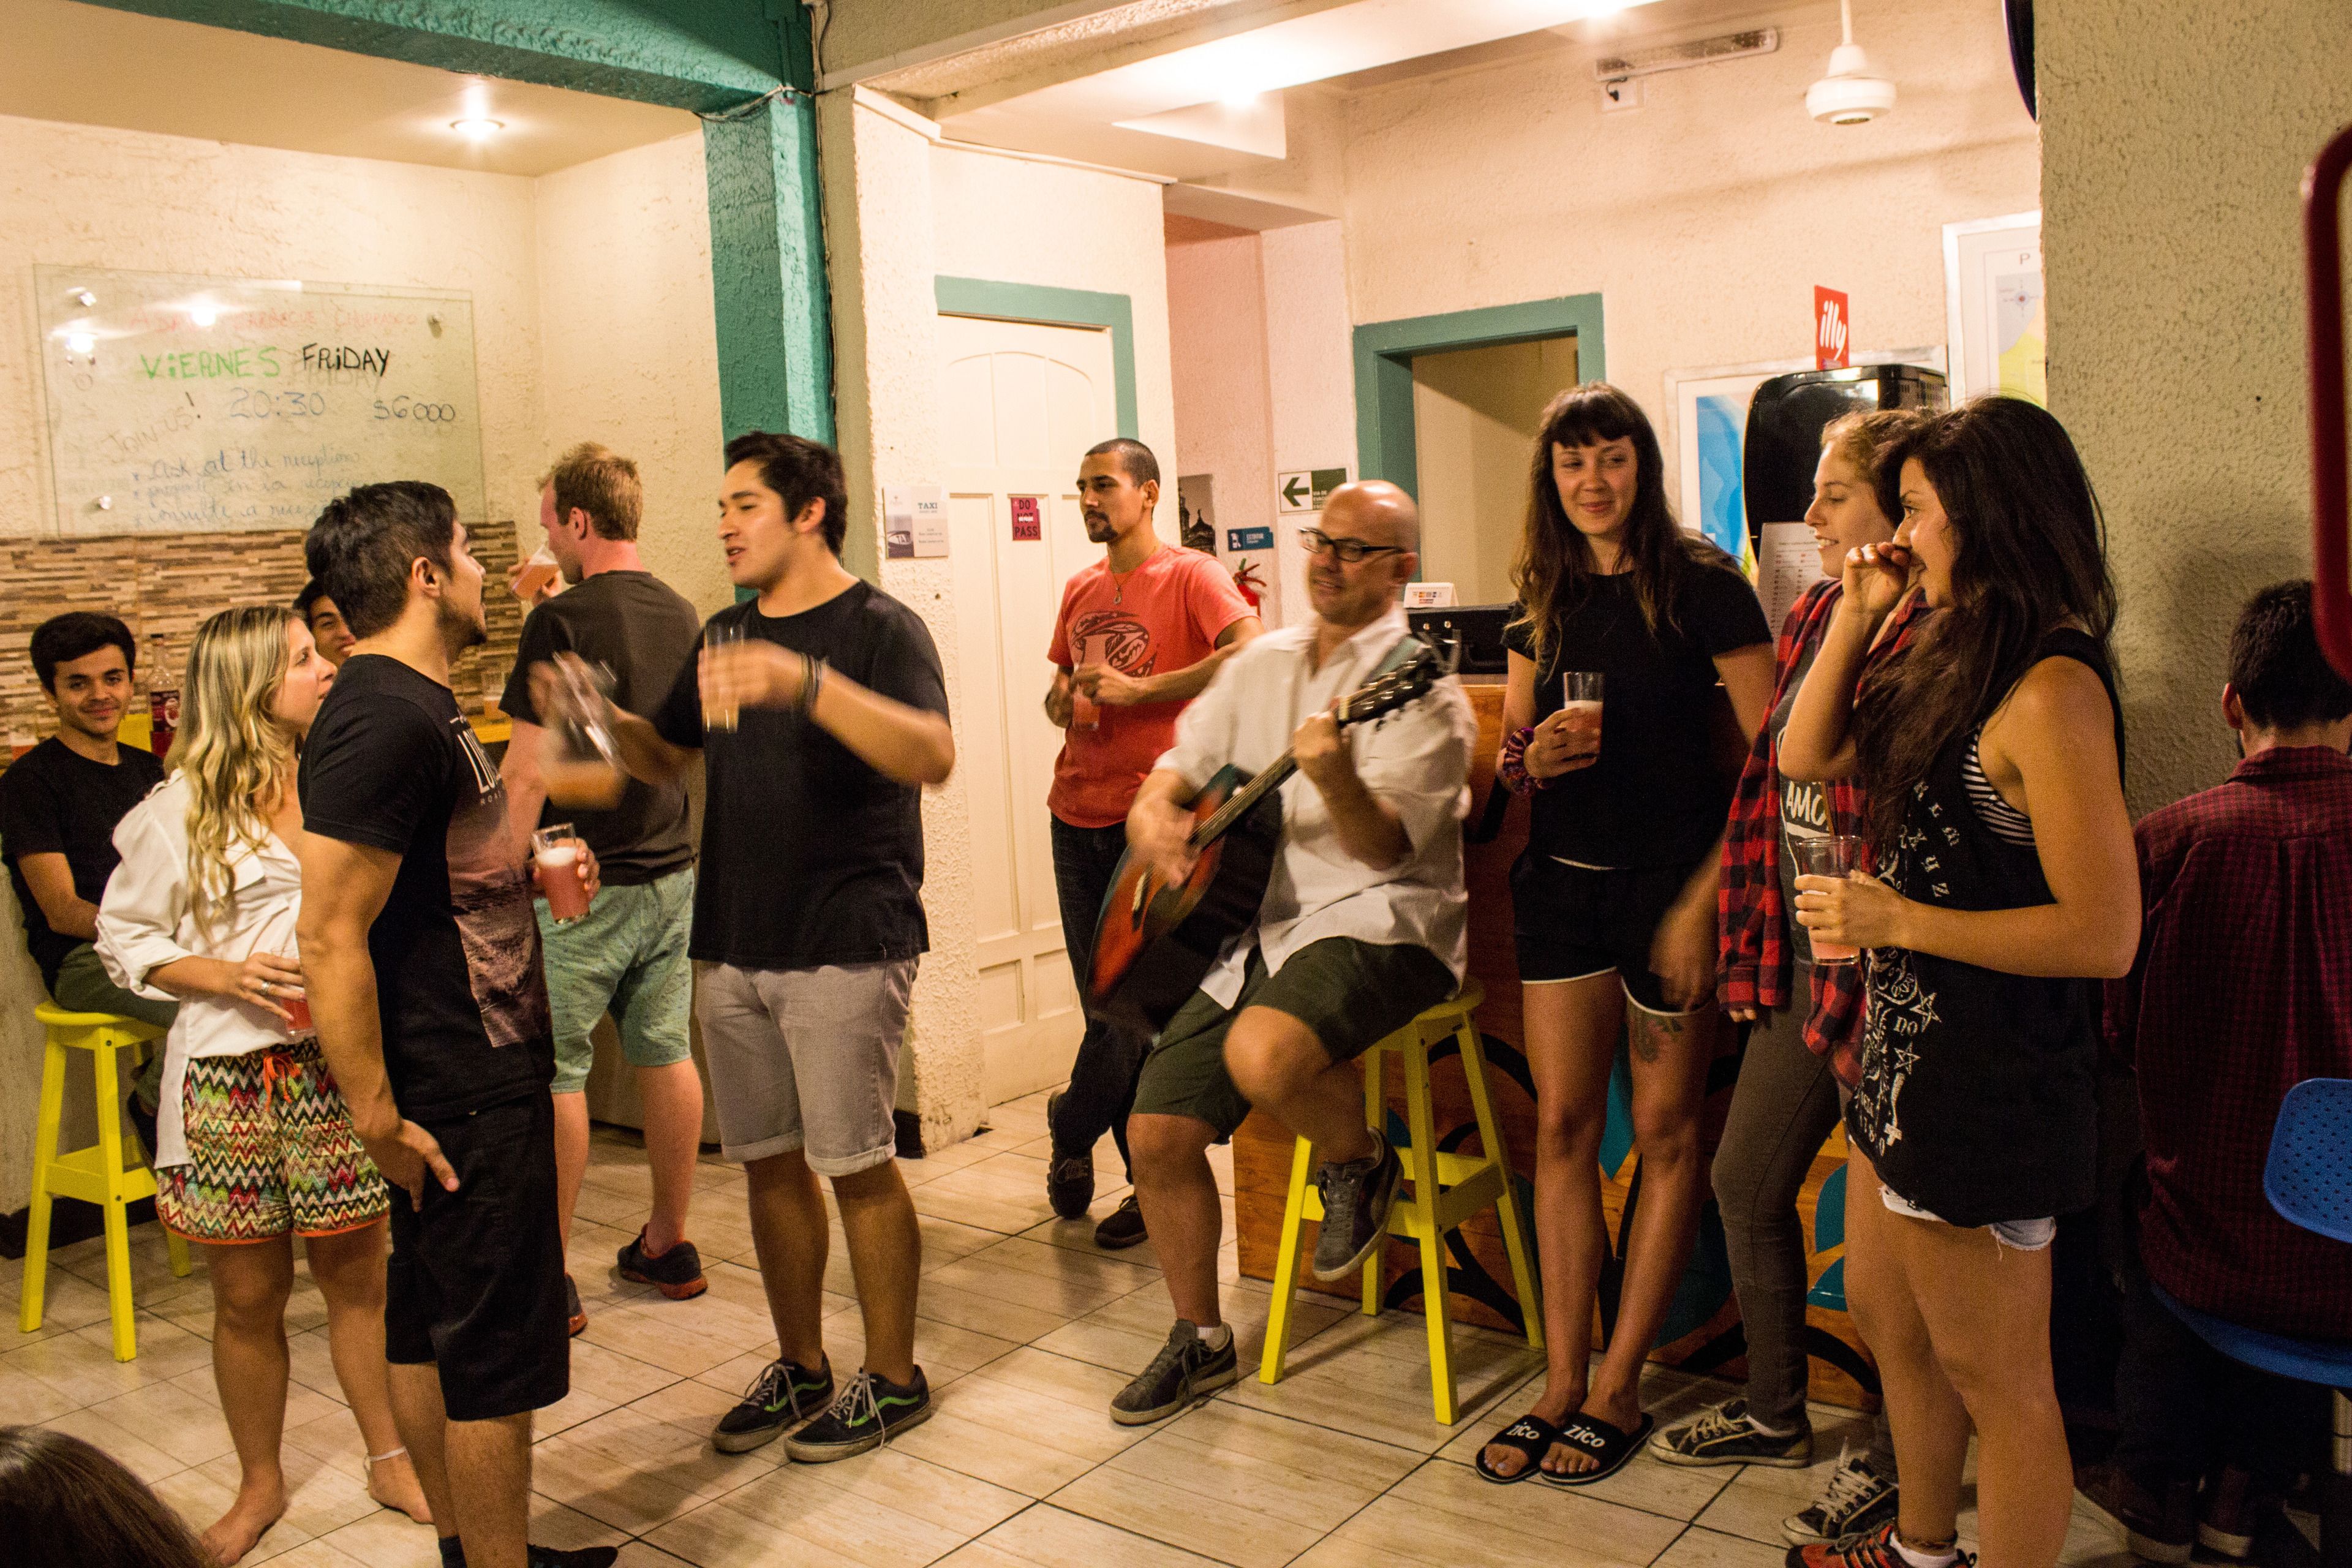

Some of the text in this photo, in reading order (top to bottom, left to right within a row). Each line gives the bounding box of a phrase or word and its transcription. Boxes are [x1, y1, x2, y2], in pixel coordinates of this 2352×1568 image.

[1820, 300, 1847, 361] illy
[230, 386, 326, 418] 20:30
[373, 395, 455, 422] $6000
[1019, 499, 1031, 510] DO
[1014, 526, 1038, 537] PASS
